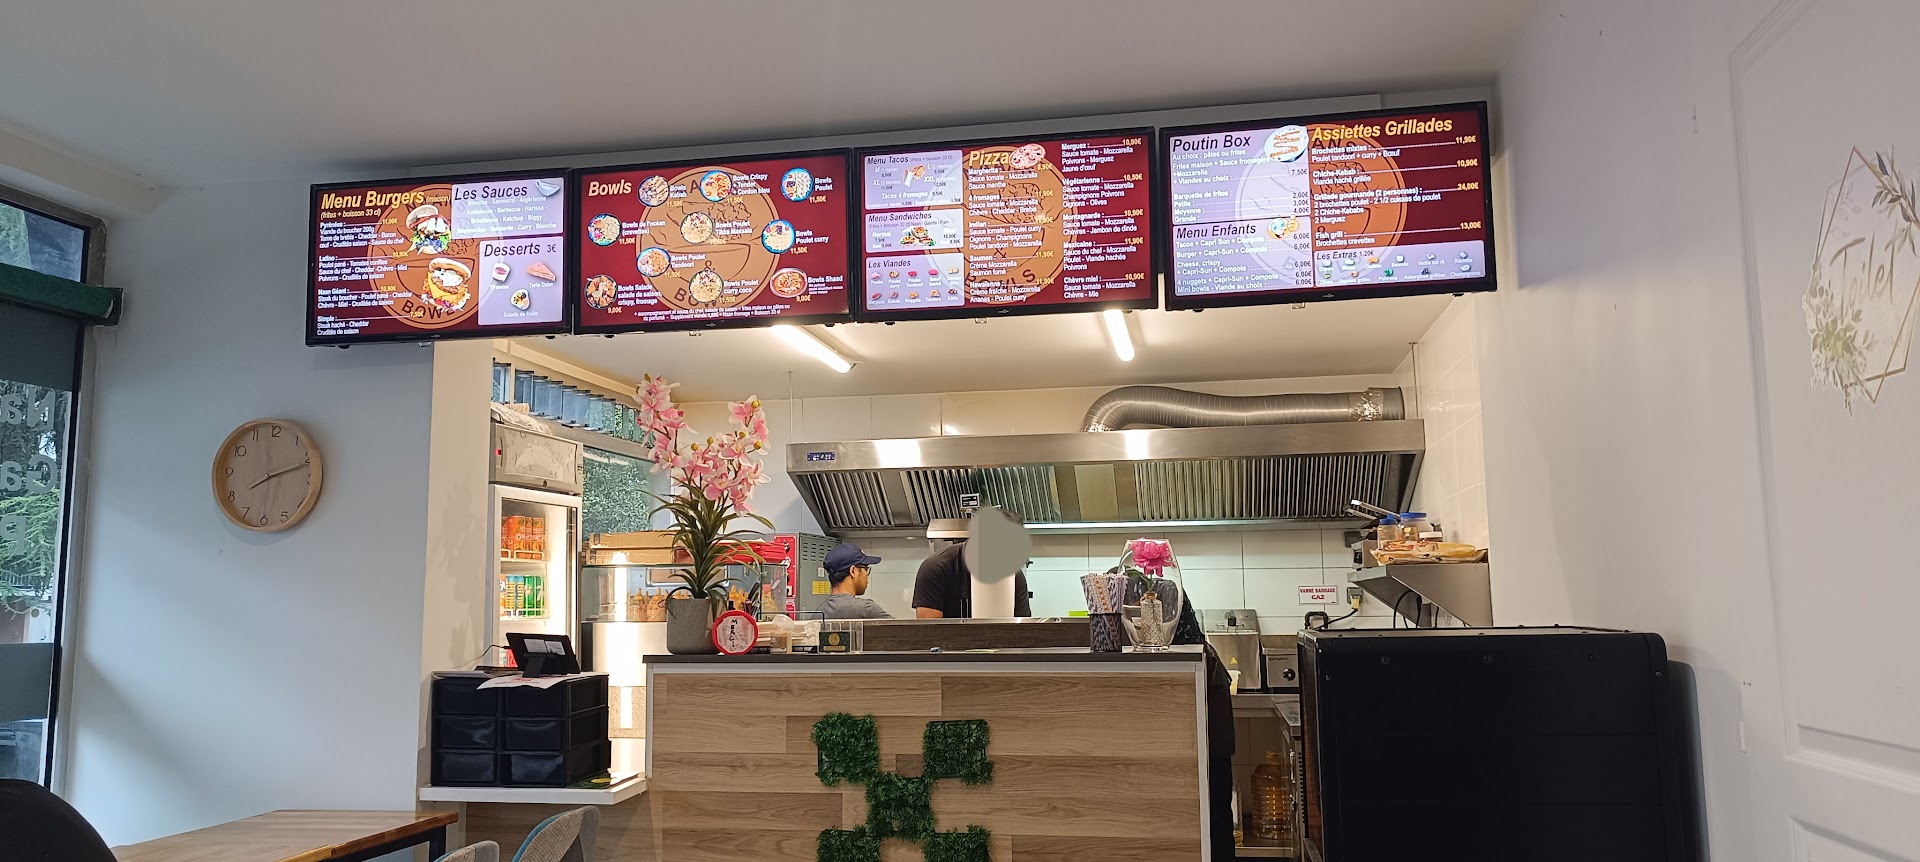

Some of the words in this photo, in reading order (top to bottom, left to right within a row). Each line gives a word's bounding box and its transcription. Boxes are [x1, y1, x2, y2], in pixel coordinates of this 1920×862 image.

[1311, 124, 1381, 142] Assiettes
[1385, 117, 1453, 136] Grillades
[1172, 137, 1218, 152] Poutin
[1223, 134, 1251, 148] Box
[969, 151, 1009, 166] Pizza
[1203, 151, 1220, 159] pâtes
[867, 157, 886, 165] Menu
[1219, 159, 1238, 167] Sauce
[1123, 173, 1142, 181] 10,50€
[1178, 177, 1202, 185] Viandes
[588, 179, 632, 196] Bowls
[1457, 182, 1480, 191] 24,00€
[454, 187, 477, 201] Les
[481, 186, 528, 199] Sauces
[1422, 193, 1441, 201] poulet
[321, 194, 361, 209] Menu
[365, 191, 424, 208] Burgers
[1320, 207, 1365, 215] Chiche-Kebabs
[889, 212, 932, 221] Sandwiches
[1320, 216, 1346, 224] Merguez
[1460, 221, 1482, 230] 13,00€
[1176, 227, 1208, 239] Menu
[1211, 224, 1256, 237] Enfants
[814, 236, 829, 244] curry
[484, 242, 541, 257] Desserts
[547, 244, 556, 253] 3€
[1176, 251, 1198, 259] Burger
[1204, 249, 1234, 257] Capri-Sun
[1316, 252, 1331, 260] Les
[1333, 251, 1357, 259] Extras
[883, 259, 911, 267] Viandes
[1203, 260, 1221, 268] crispy
[1295, 260, 1311, 268] 6,00€
[1219, 265, 1247, 273] Compote
[1213, 276, 1244, 284] Capri-Sun
[271, 425, 281, 437] 12
[252, 430, 258, 442] 11
[235, 445, 246, 457] 10
[225, 467, 234, 478] 9
[228, 491, 235, 503] 8
[242, 506, 250, 519] 7
[280, 511, 288, 523] 5
[260, 514, 268, 525] 6
